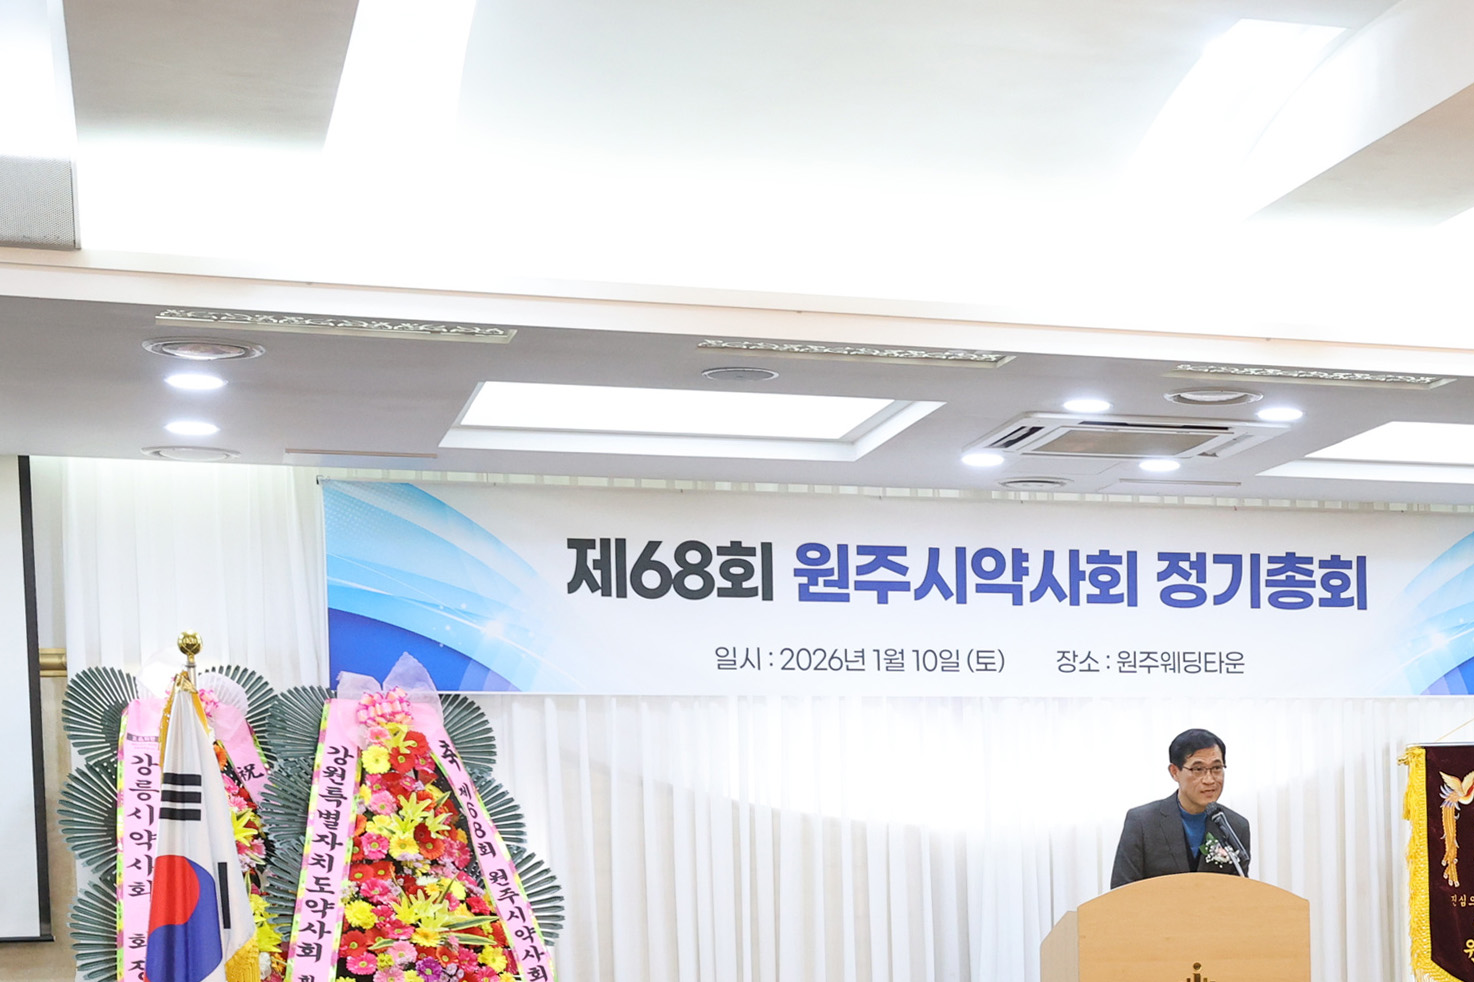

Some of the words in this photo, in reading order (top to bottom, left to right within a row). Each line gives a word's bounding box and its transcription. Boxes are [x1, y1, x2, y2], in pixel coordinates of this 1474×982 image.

[567, 537, 774, 602] 제68회
[793, 541, 1139, 608] 원주시약사회
[1156, 551, 1368, 611] 정기총회
[714, 646, 761, 671] 일시
[779, 647, 866, 672] 2026년
[872, 648, 905, 672] 1월
[912, 648, 961, 673] 10일
[966, 648, 1005, 673] (토)
[1056, 650, 1101, 674] 장소
[1116, 650, 1246, 674] 원주웨딩타운
[236, 763, 265, 782] 祝
[127, 753, 160, 898] 강릉시약사회
[296, 745, 354, 963] 강원특별자치도약사회
[440, 740, 461, 772] 축
[457, 782, 497, 859] 제68회
[488, 868, 549, 982] 원주시약사회
